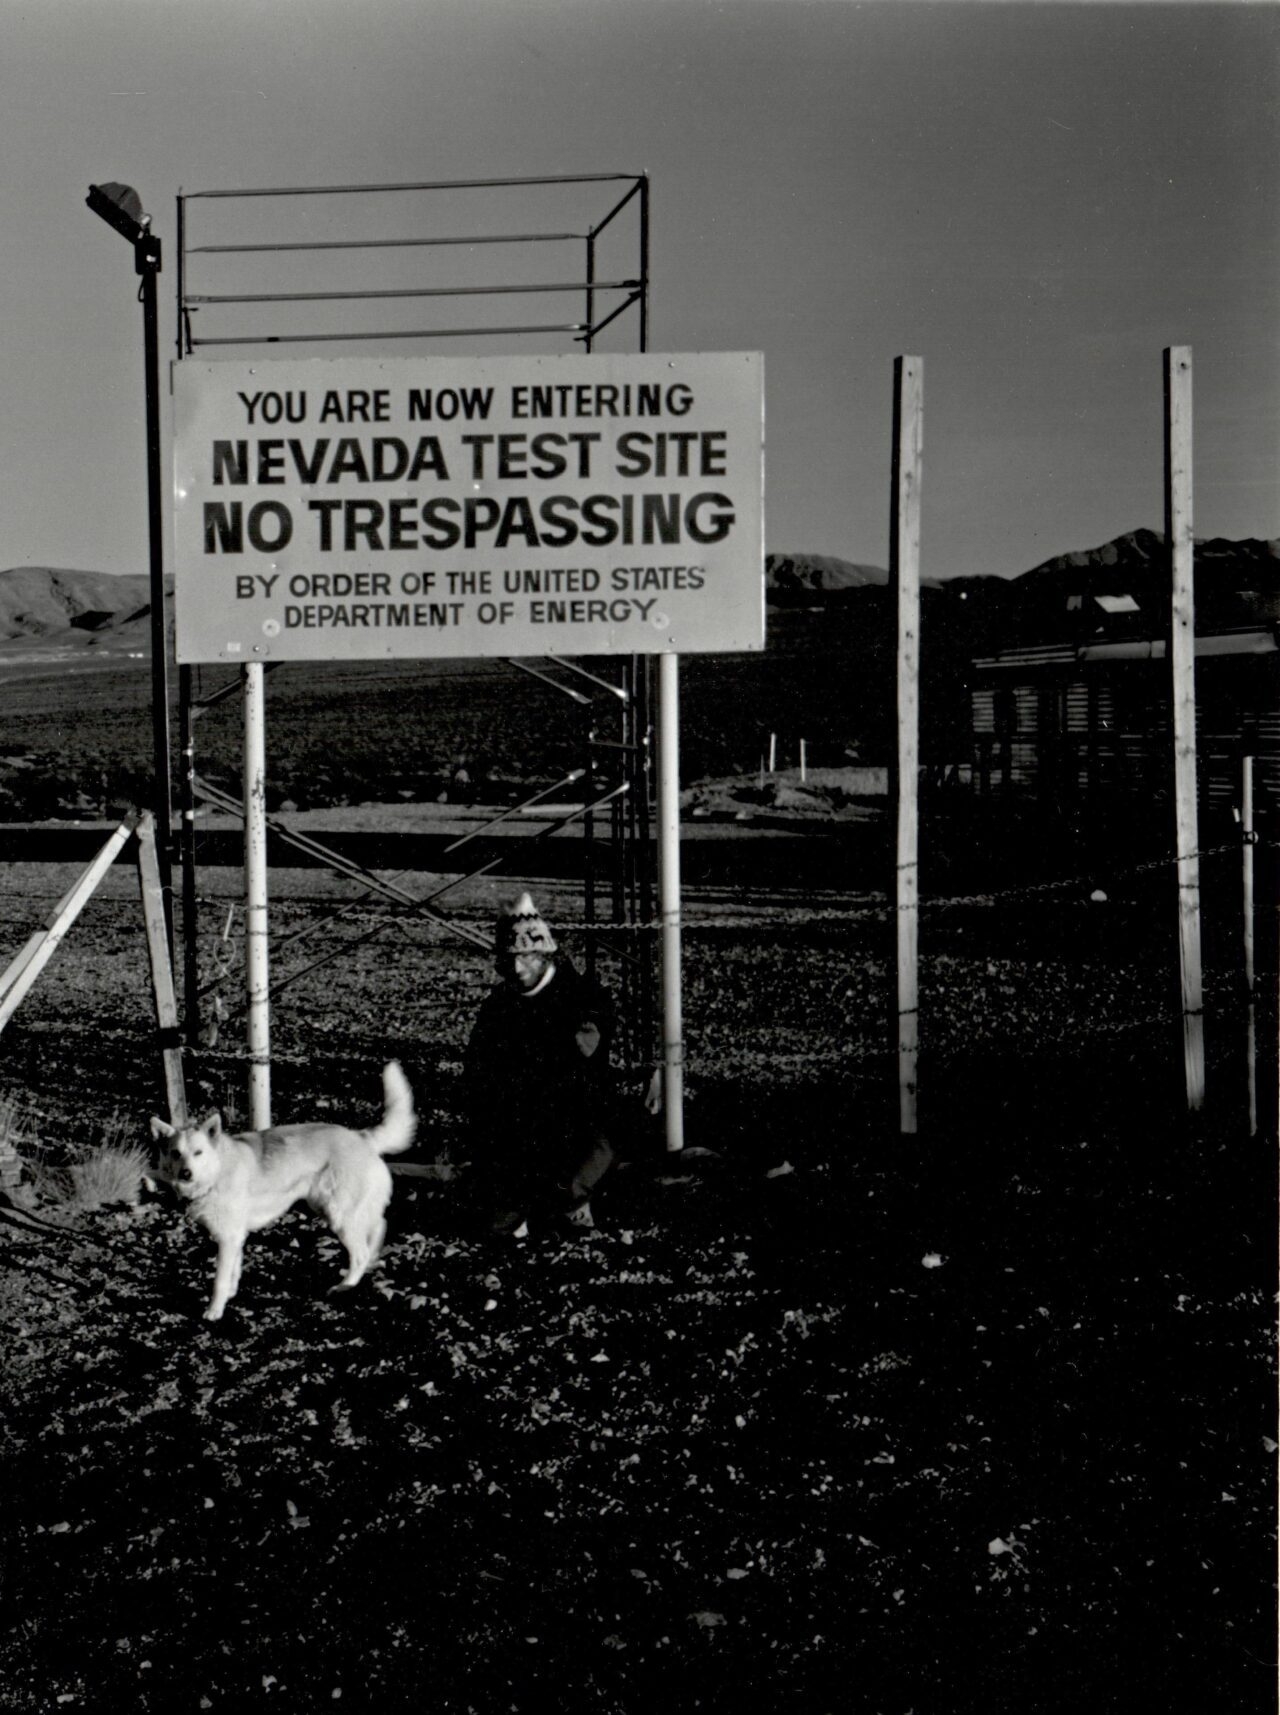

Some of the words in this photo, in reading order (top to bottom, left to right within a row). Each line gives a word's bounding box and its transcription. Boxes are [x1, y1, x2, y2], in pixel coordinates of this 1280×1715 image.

[238, 390, 307, 425] YOU
[319, 389, 391, 424] ARE
[408, 386, 495, 422] NOW
[511, 383, 695, 419] ENTERING
[212, 435, 451, 486] NEVADA
[461, 431, 602, 481] TEST
[615, 430, 728, 479] SITE
[203, 500, 294, 555] NO
[307, 491, 736, 552] TRESPASSING
[236, 574, 280, 600] BY
[288, 572, 392, 598] ORDER
[400, 571, 436, 596] OF
[445, 570, 492, 595] THE
[503, 568, 601, 594] UNITED
[611, 566, 705, 592] STATES
[284, 602, 465, 629] DEPARTMENT
[477, 601, 514, 625] OF
[529, 598, 658, 624] ENERGY
